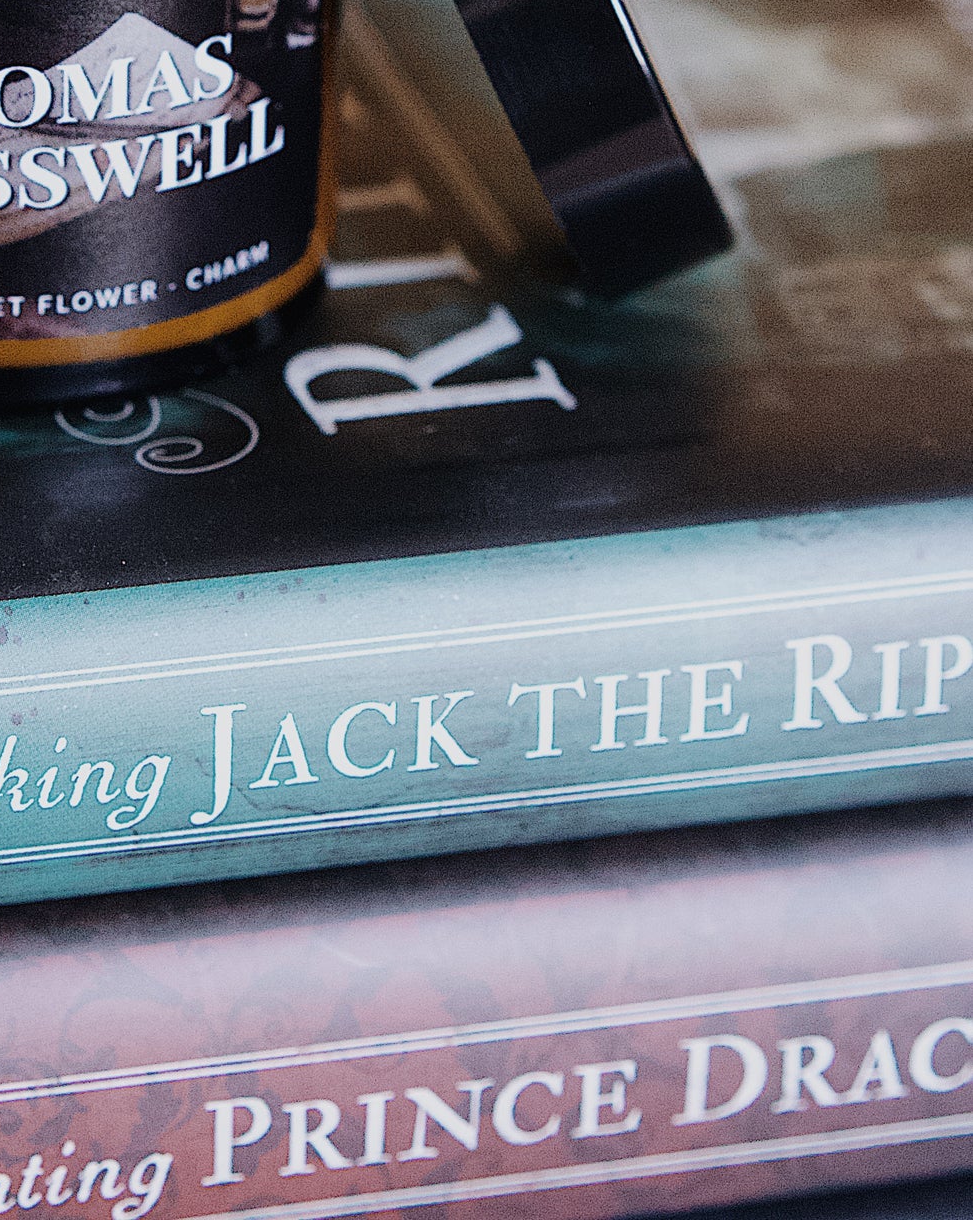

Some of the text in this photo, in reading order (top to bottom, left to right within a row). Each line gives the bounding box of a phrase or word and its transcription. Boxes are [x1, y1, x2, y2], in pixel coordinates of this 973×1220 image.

[37, 279, 158, 316] FLOWER
[185, 240, 270, 291] CHARM
[189, 690, 480, 825] JACK
[506, 659, 750, 762] THE
[200, 1058, 643, 1188] PRINCE
[670, 1016, 973, 1127] DRAC
